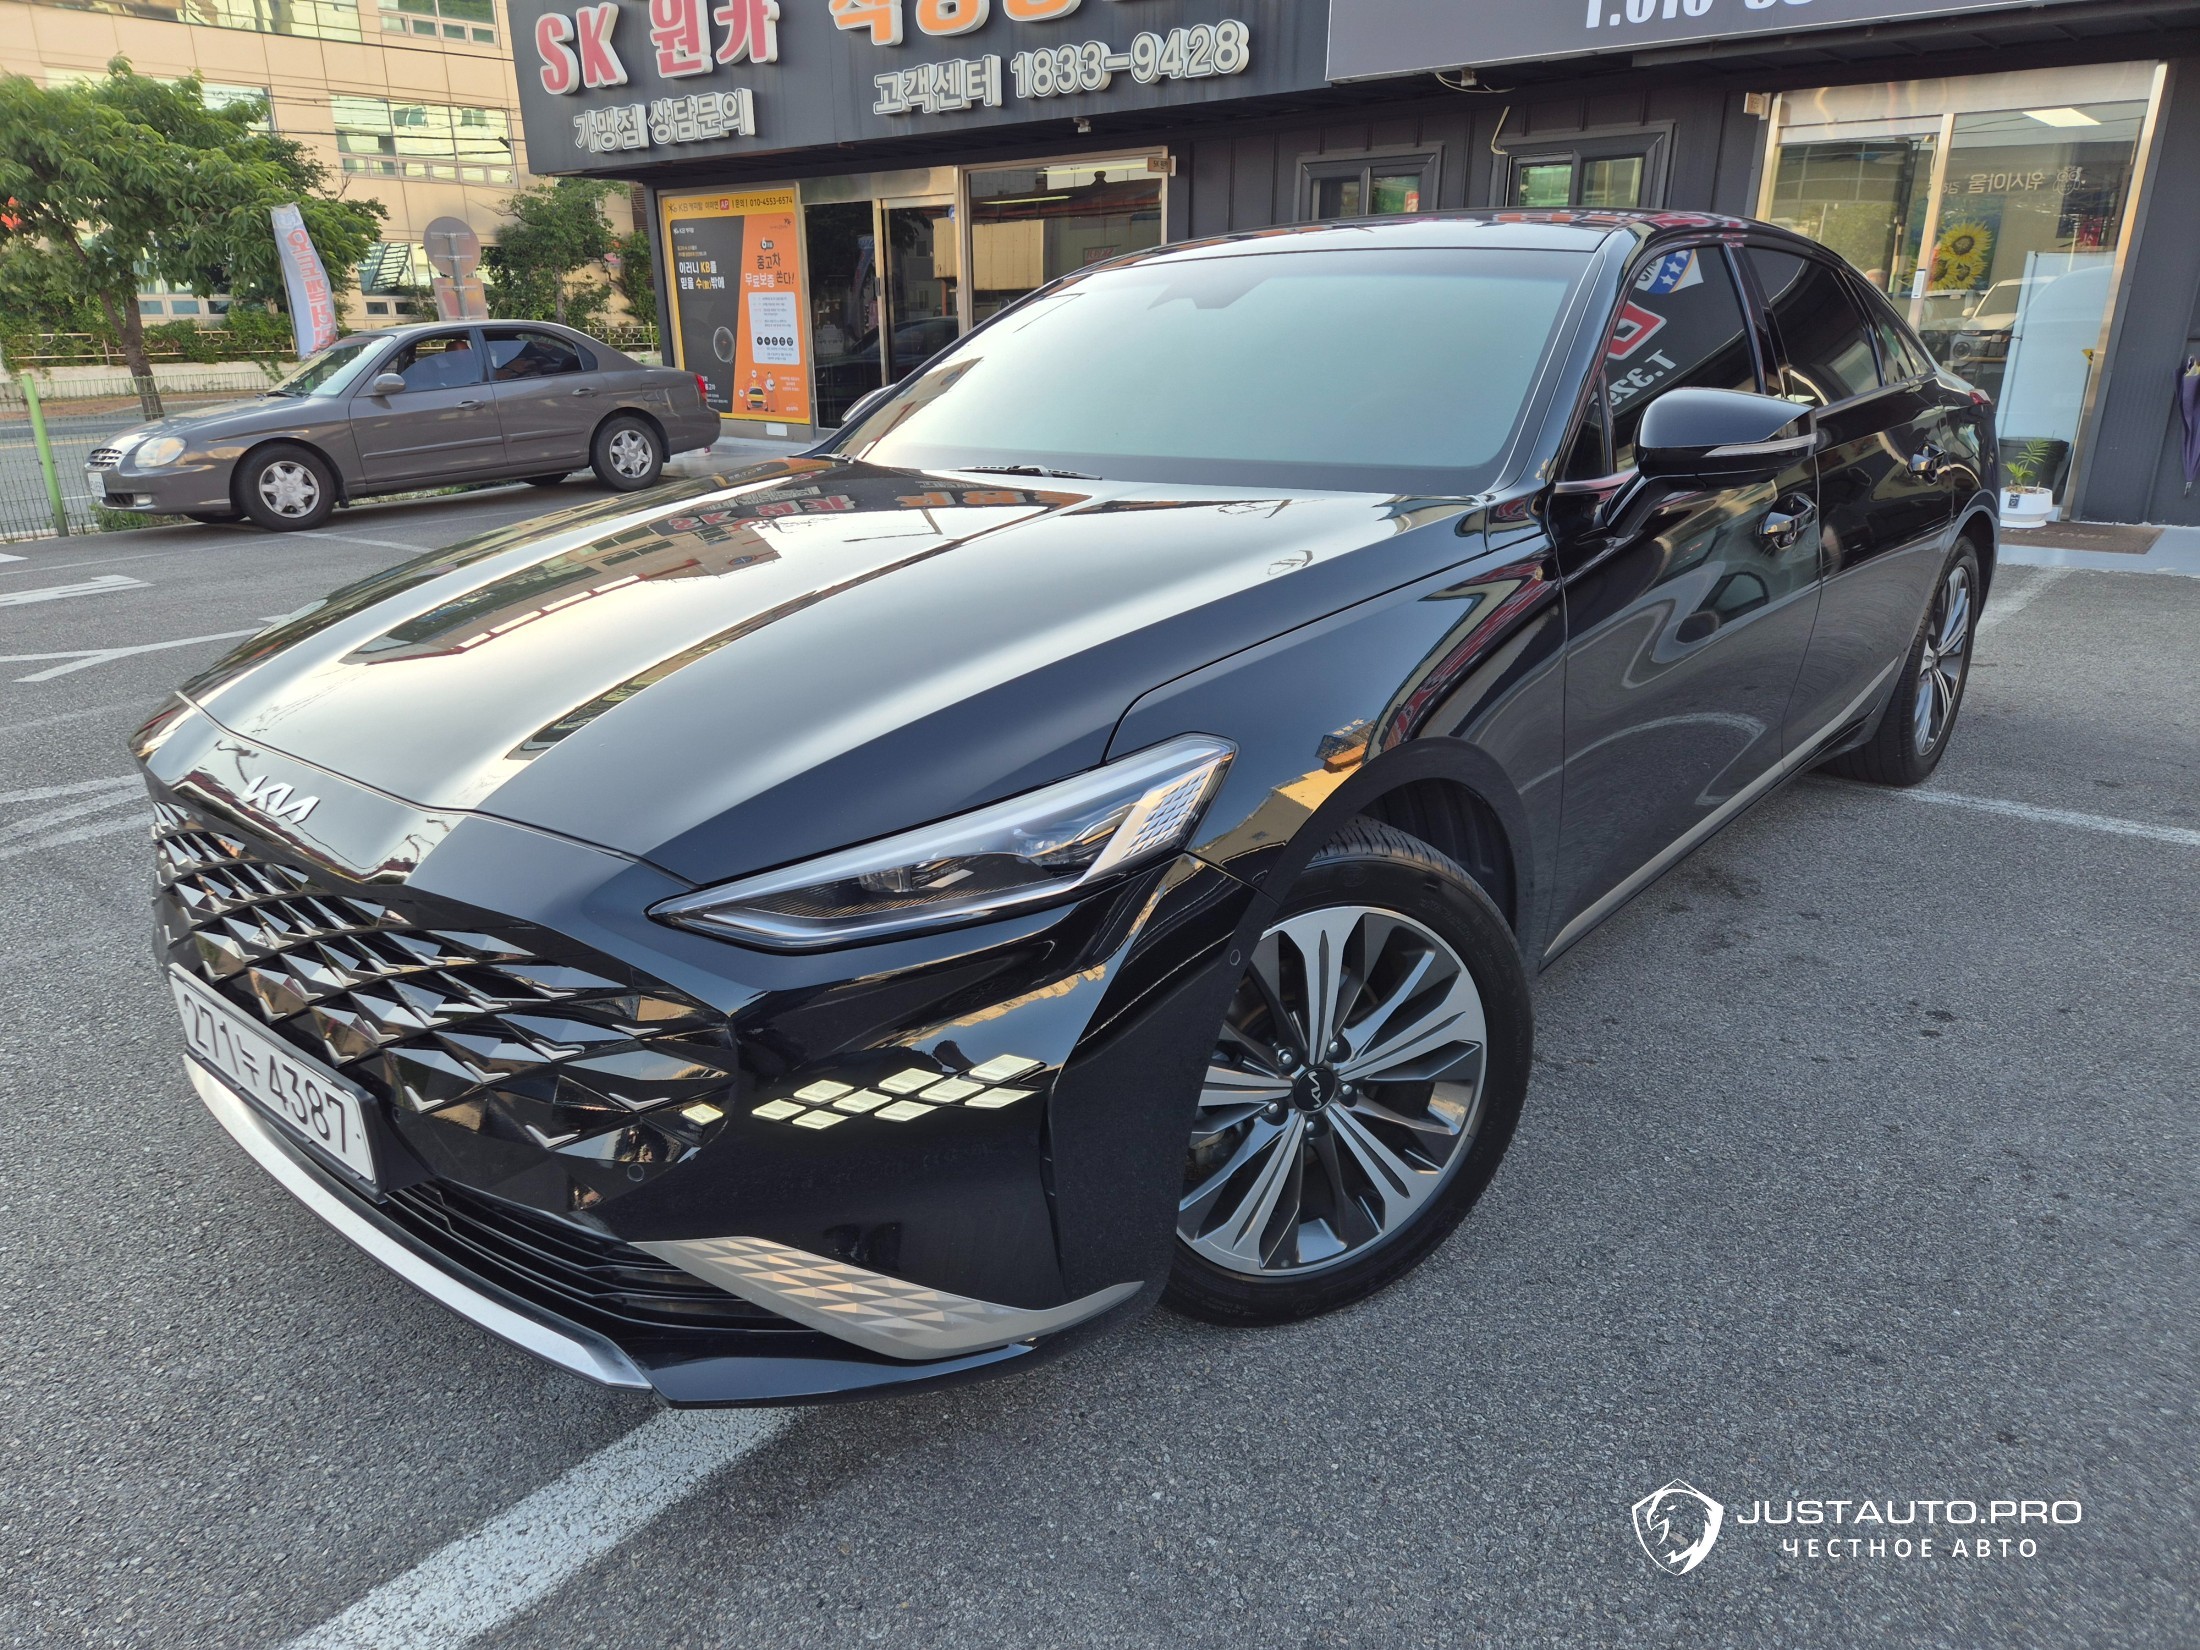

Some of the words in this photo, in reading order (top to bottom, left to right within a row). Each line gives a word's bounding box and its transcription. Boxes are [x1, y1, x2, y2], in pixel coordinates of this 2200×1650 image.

[535, 2, 627, 95] SK
[650, 0, 779, 78] 원카
[874, 55, 1000, 115] 고객센터
[1011, 19, 1247, 99] 1833-9428
[574, 104, 647, 153] 가맹점
[648, 88, 754, 145] 상담문의
[721, 200, 729, 209] AP
[678, 261, 699, 274] 이러니
[745, 272, 775, 288] 무료보증
[757, 252, 781, 270] 중고차
[242, 775, 321, 825] KIA
[270, 1054, 347, 1154] 4387
